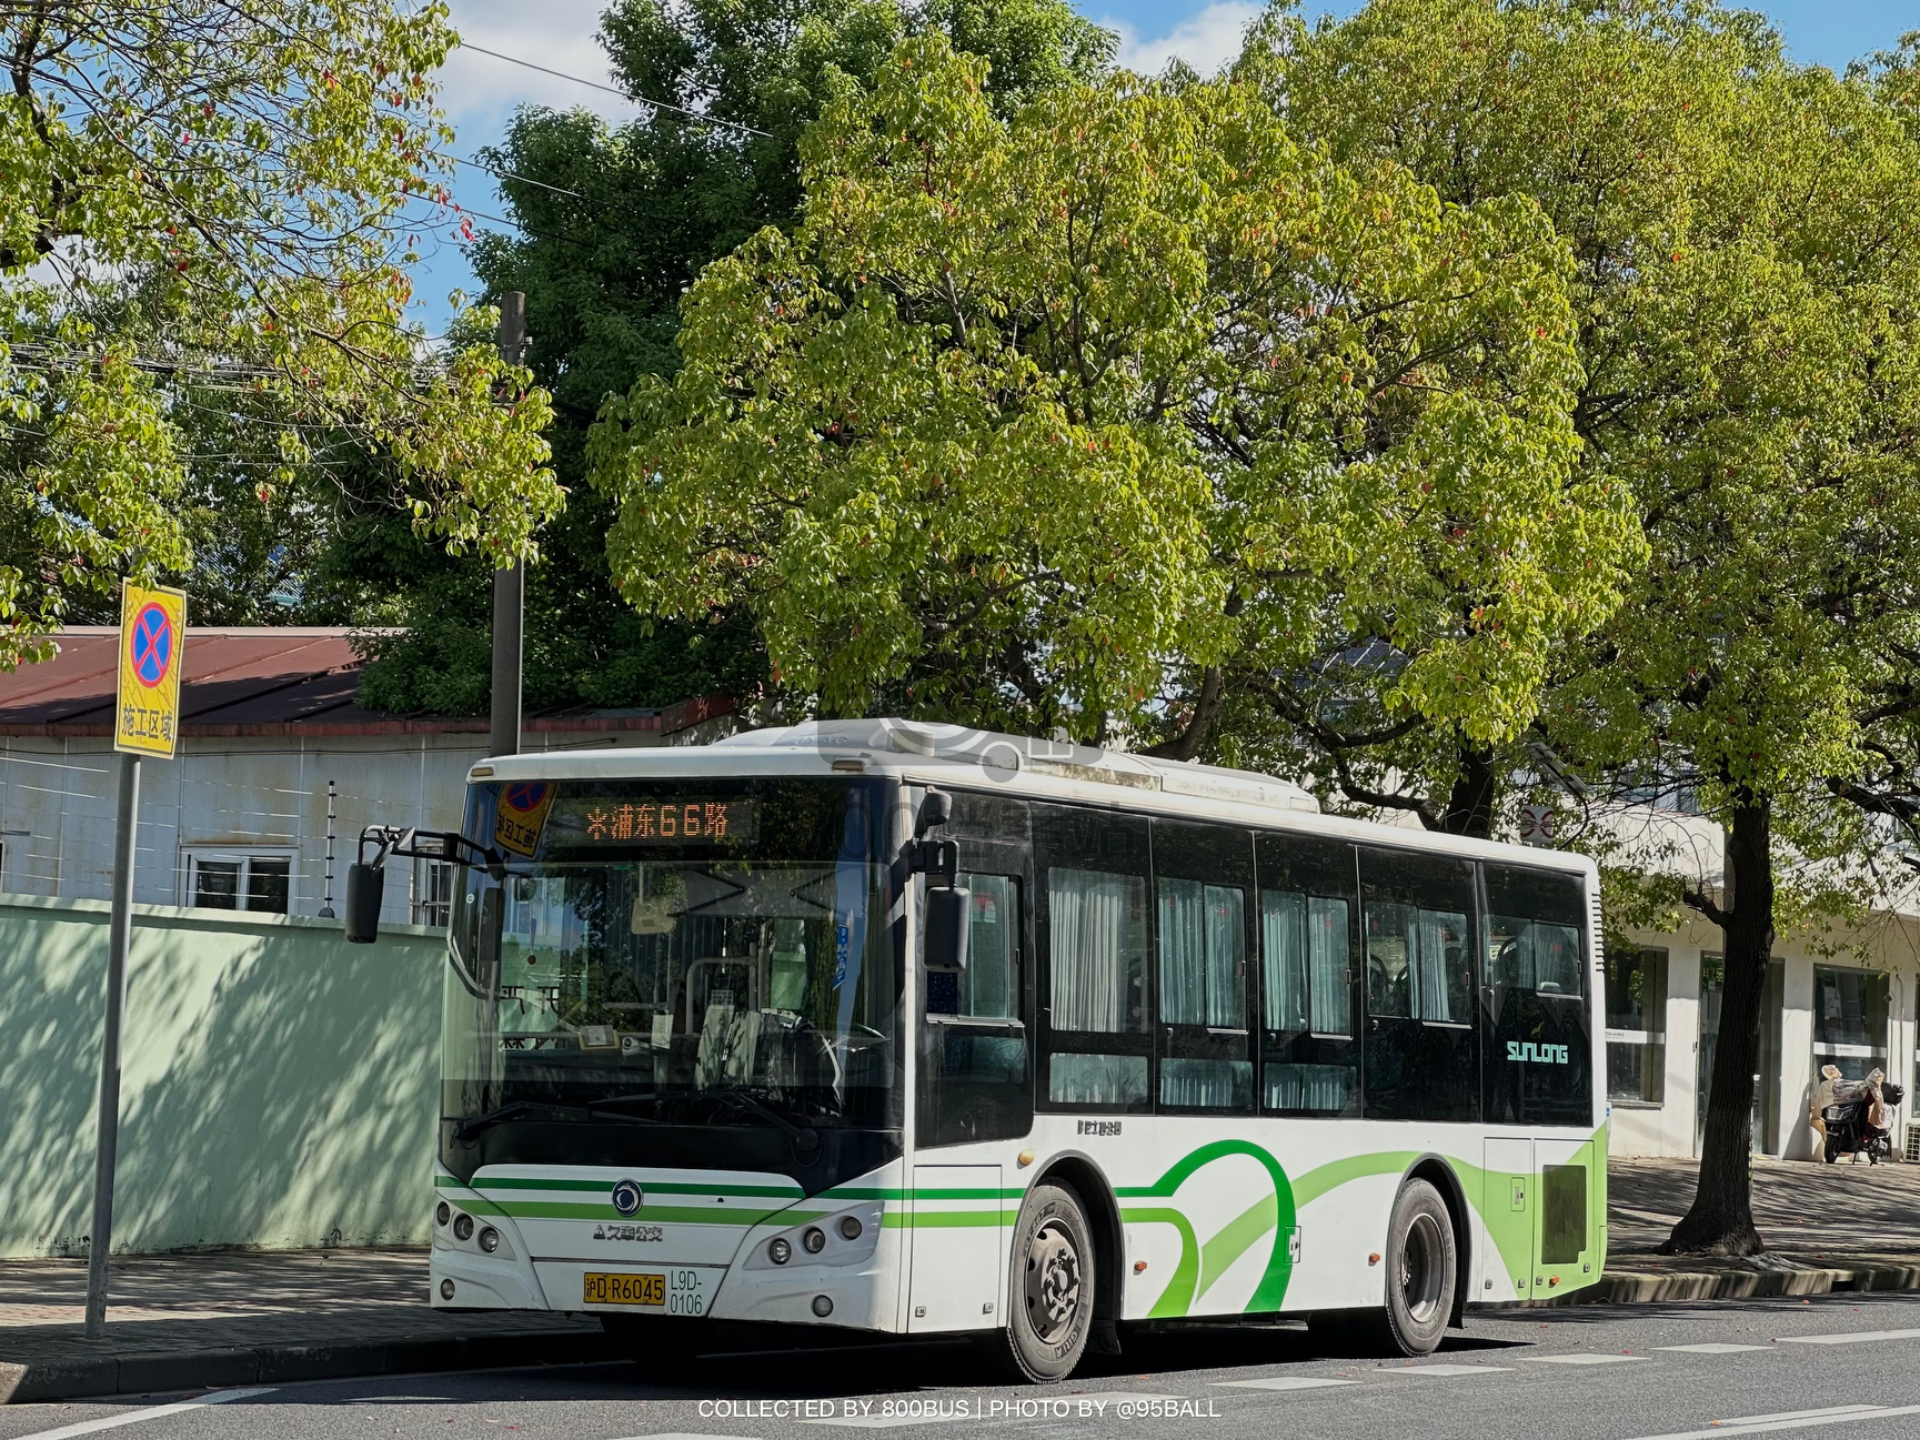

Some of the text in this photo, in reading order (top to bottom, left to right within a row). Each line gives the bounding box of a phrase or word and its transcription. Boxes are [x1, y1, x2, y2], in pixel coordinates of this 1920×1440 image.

[122, 703, 174, 742] 施工区域
[1507, 1041, 1568, 1064] SUNLONG
[670, 1271, 702, 1291] L9D-
[670, 1294, 702, 1314] 0106
